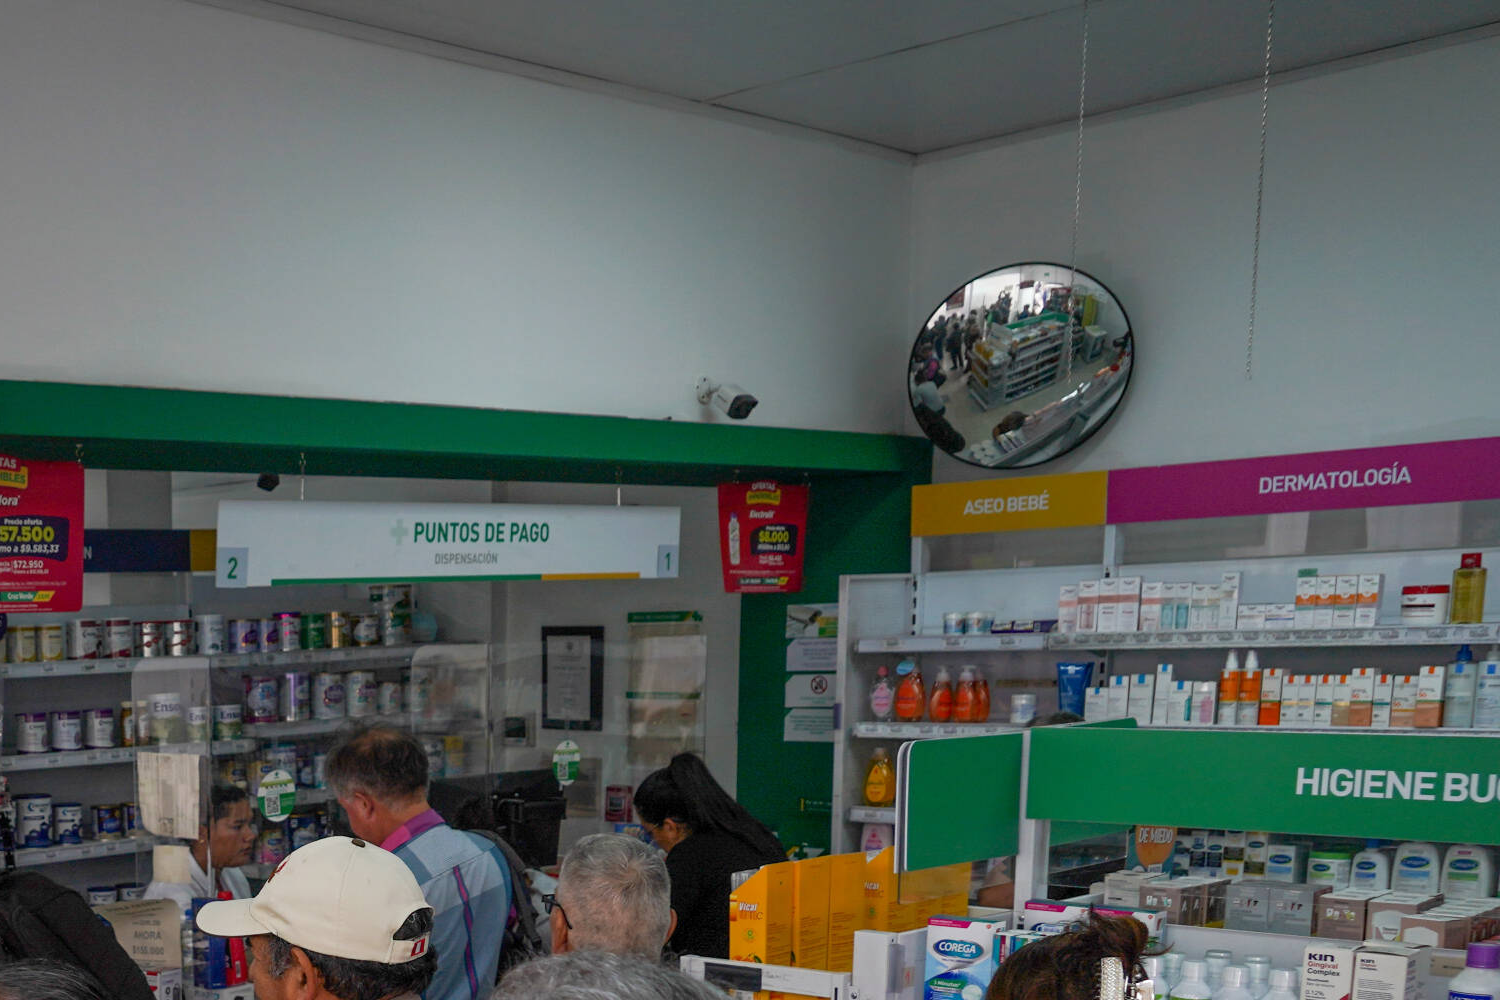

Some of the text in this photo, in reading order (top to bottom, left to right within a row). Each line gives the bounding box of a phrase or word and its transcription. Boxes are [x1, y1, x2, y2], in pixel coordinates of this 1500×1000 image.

[1259, 461, 1411, 495] DERMATOLOGÍA
[964, 490, 1049, 516] ASEO BEBÉ
[4, 518, 43, 526] Precio oferta
[413, 522, 549, 543] PUNTOS DE PAGO
[13, 560, 43, 569] $72.950
[434, 552, 498, 565] DISPENSACIÓN
[664, 553, 671, 571] 1
[227, 557, 238, 579] 2
[1296, 767, 1437, 800] HIGIENE
[1139, 828, 1149, 843] DE
[939, 941, 977, 954] COREGA
[1307, 968, 1340, 976] Complex
[1308, 961, 1338, 969] Gingival
